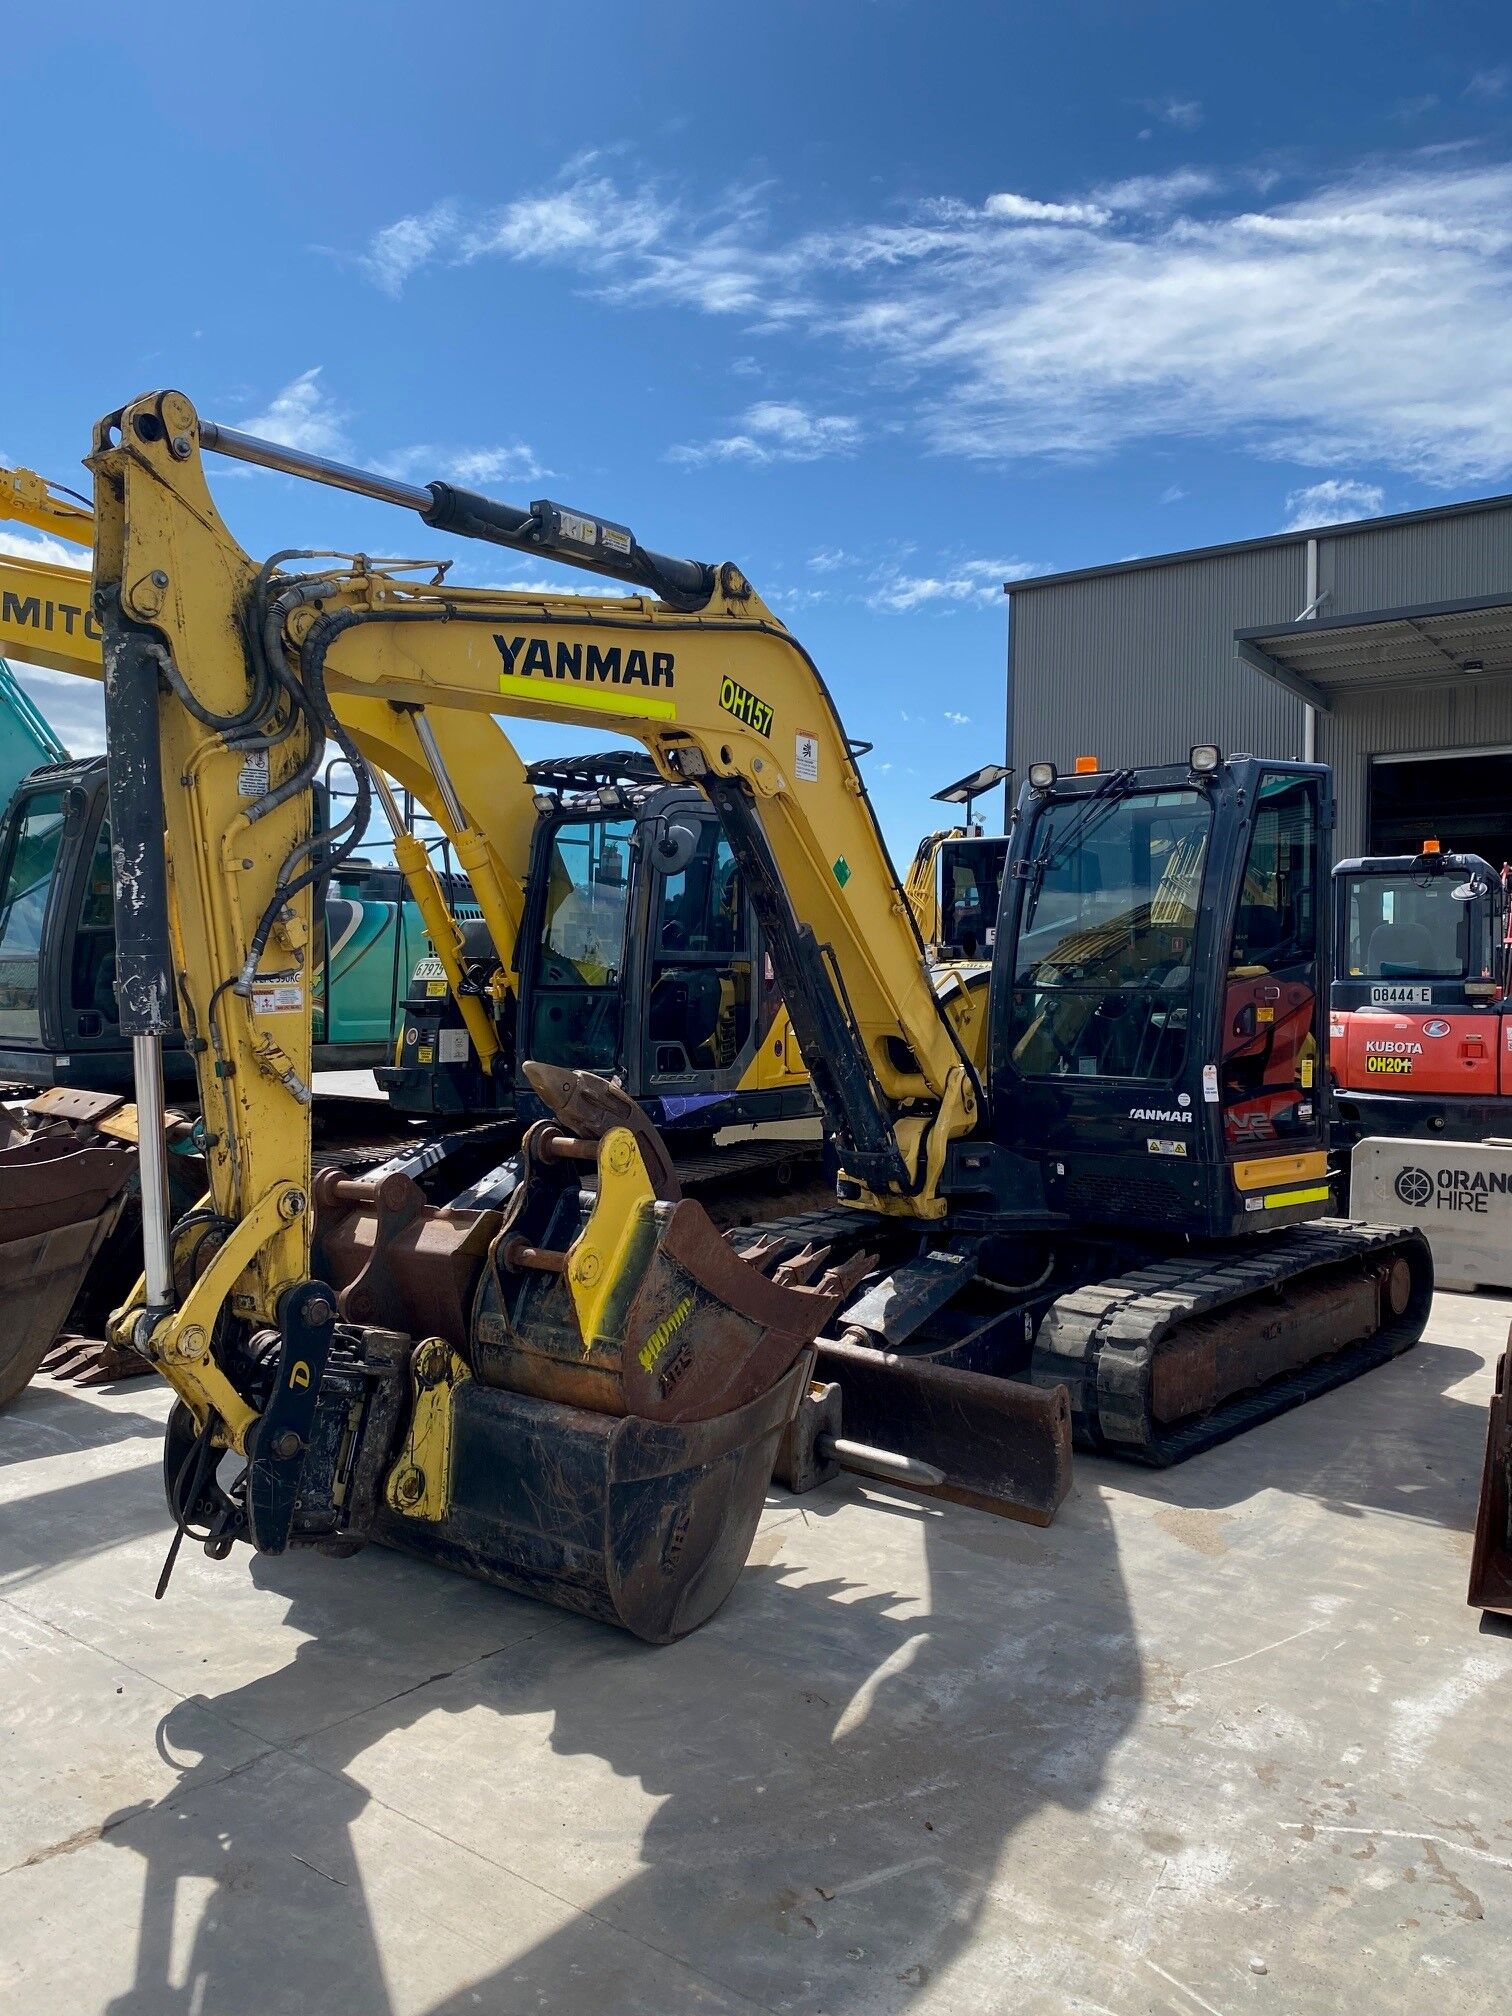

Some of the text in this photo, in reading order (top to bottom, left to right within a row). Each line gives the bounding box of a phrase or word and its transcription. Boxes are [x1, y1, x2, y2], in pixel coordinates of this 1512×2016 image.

[493, 634, 675, 688] YANMAR
[721, 679, 773, 735] OH157
[1366, 1041, 1423, 1054] KUBOTA
[1437, 1169, 1512, 1194] ORAN
[1437, 1190, 1488, 1213] HIRE
